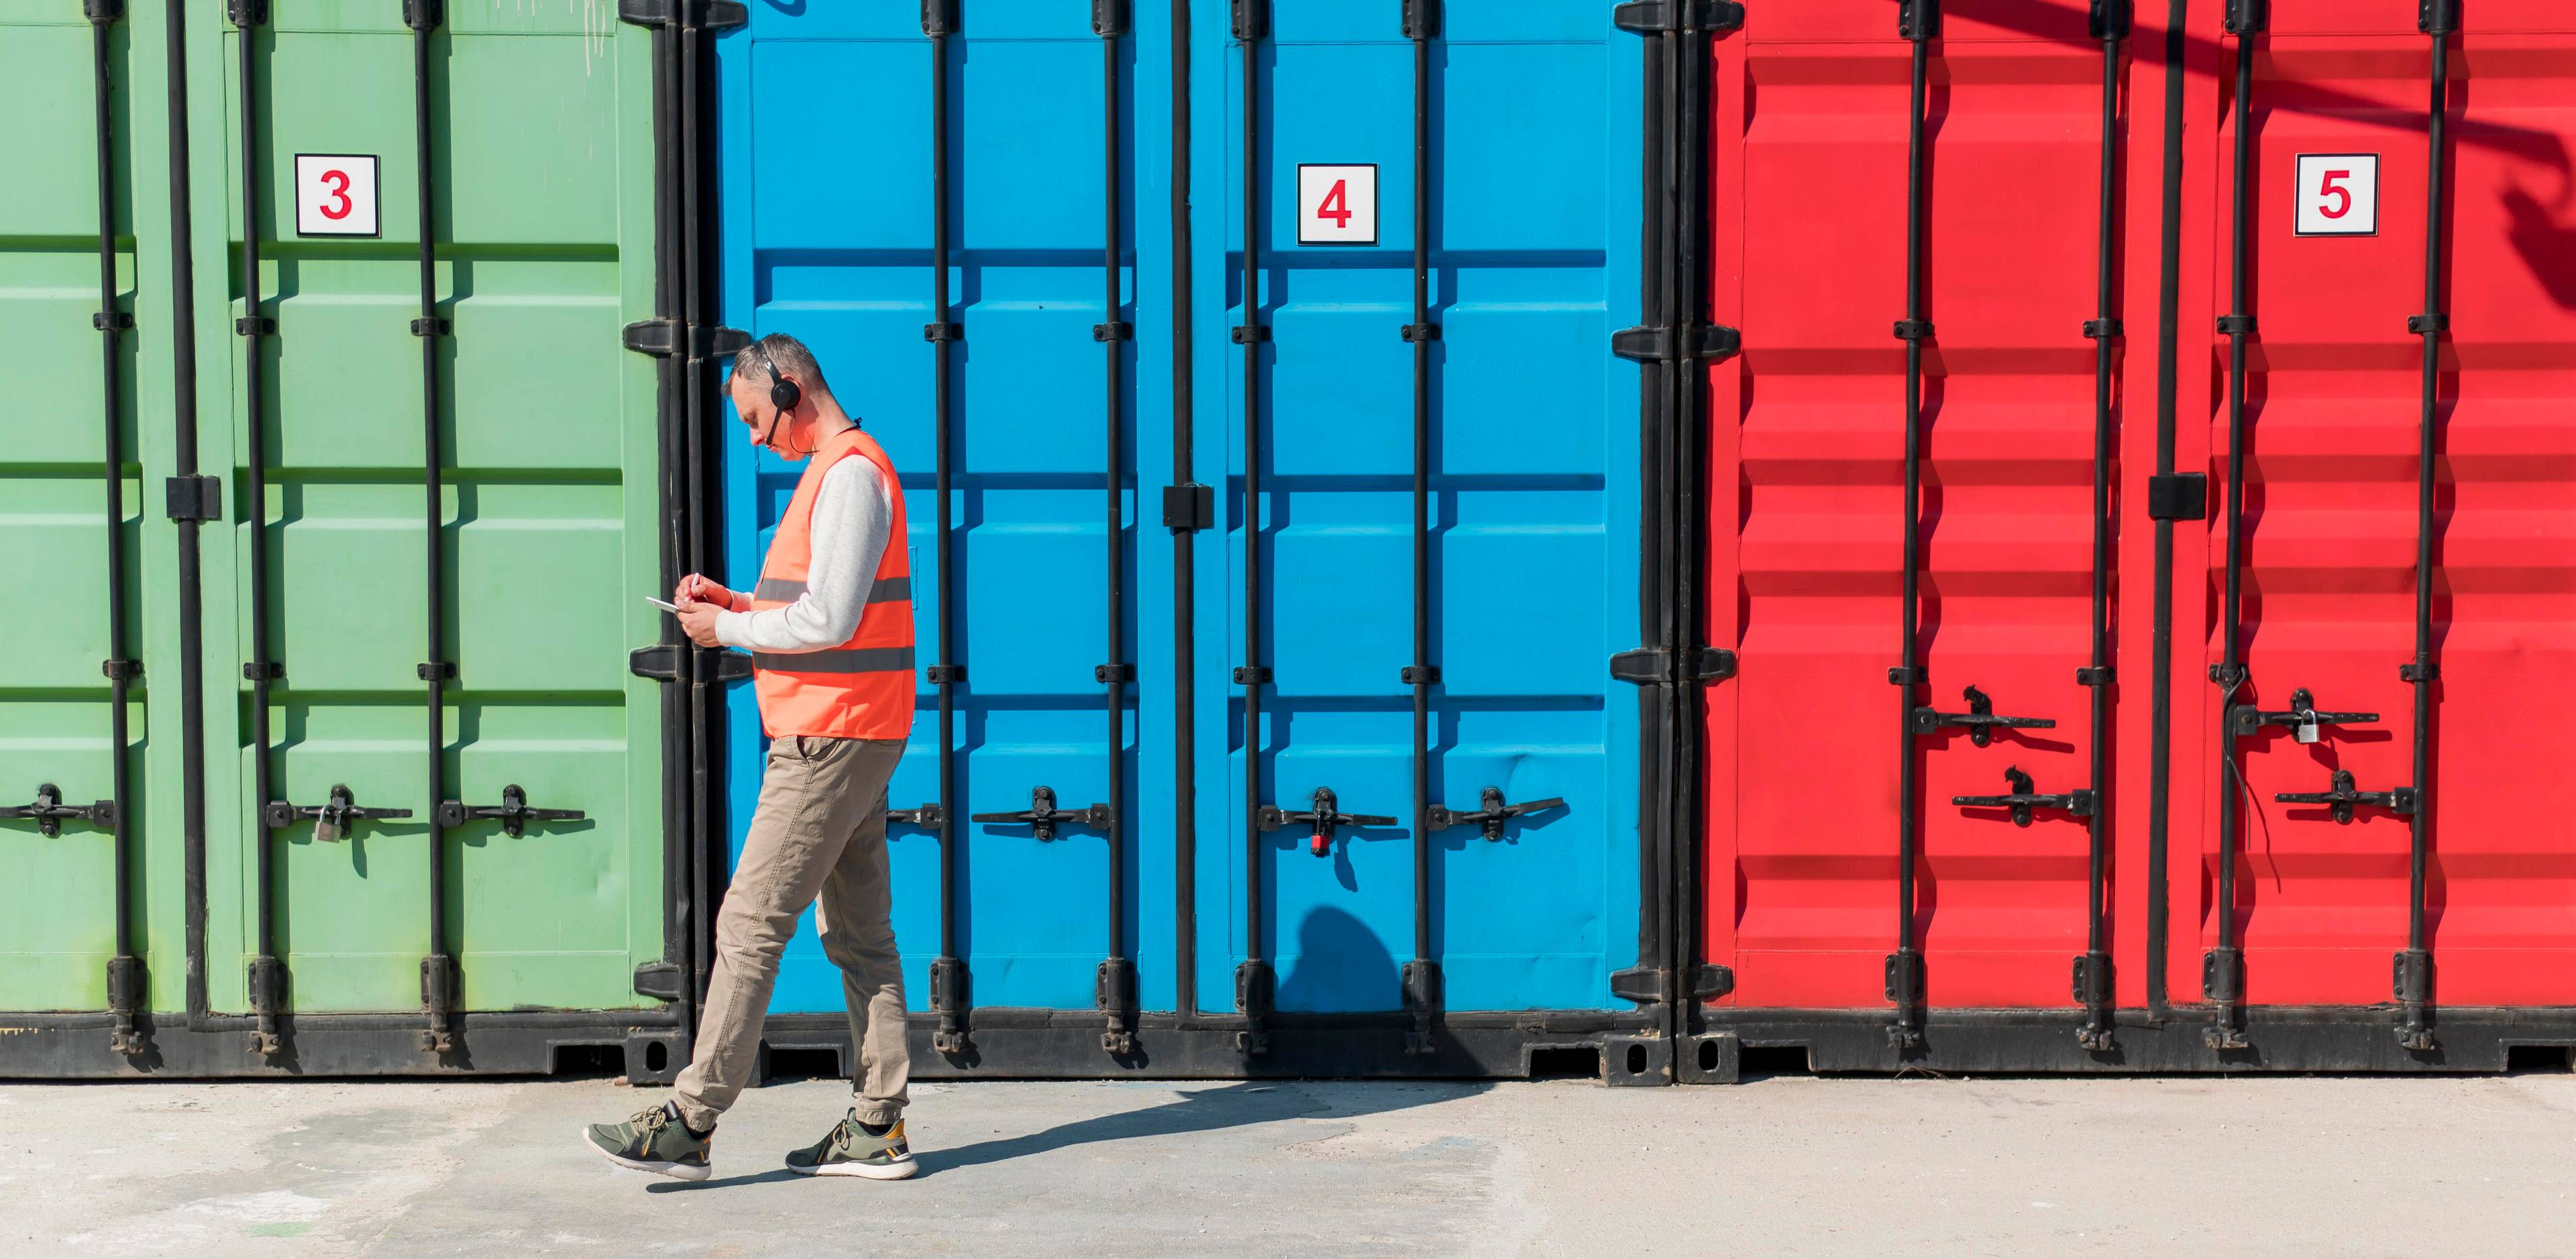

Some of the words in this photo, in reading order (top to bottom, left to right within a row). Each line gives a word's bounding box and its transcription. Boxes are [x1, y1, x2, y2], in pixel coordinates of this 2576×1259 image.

[320, 170, 352, 219] 3
[1318, 180, 1351, 228] 4
[2318, 170, 2351, 219] 5
